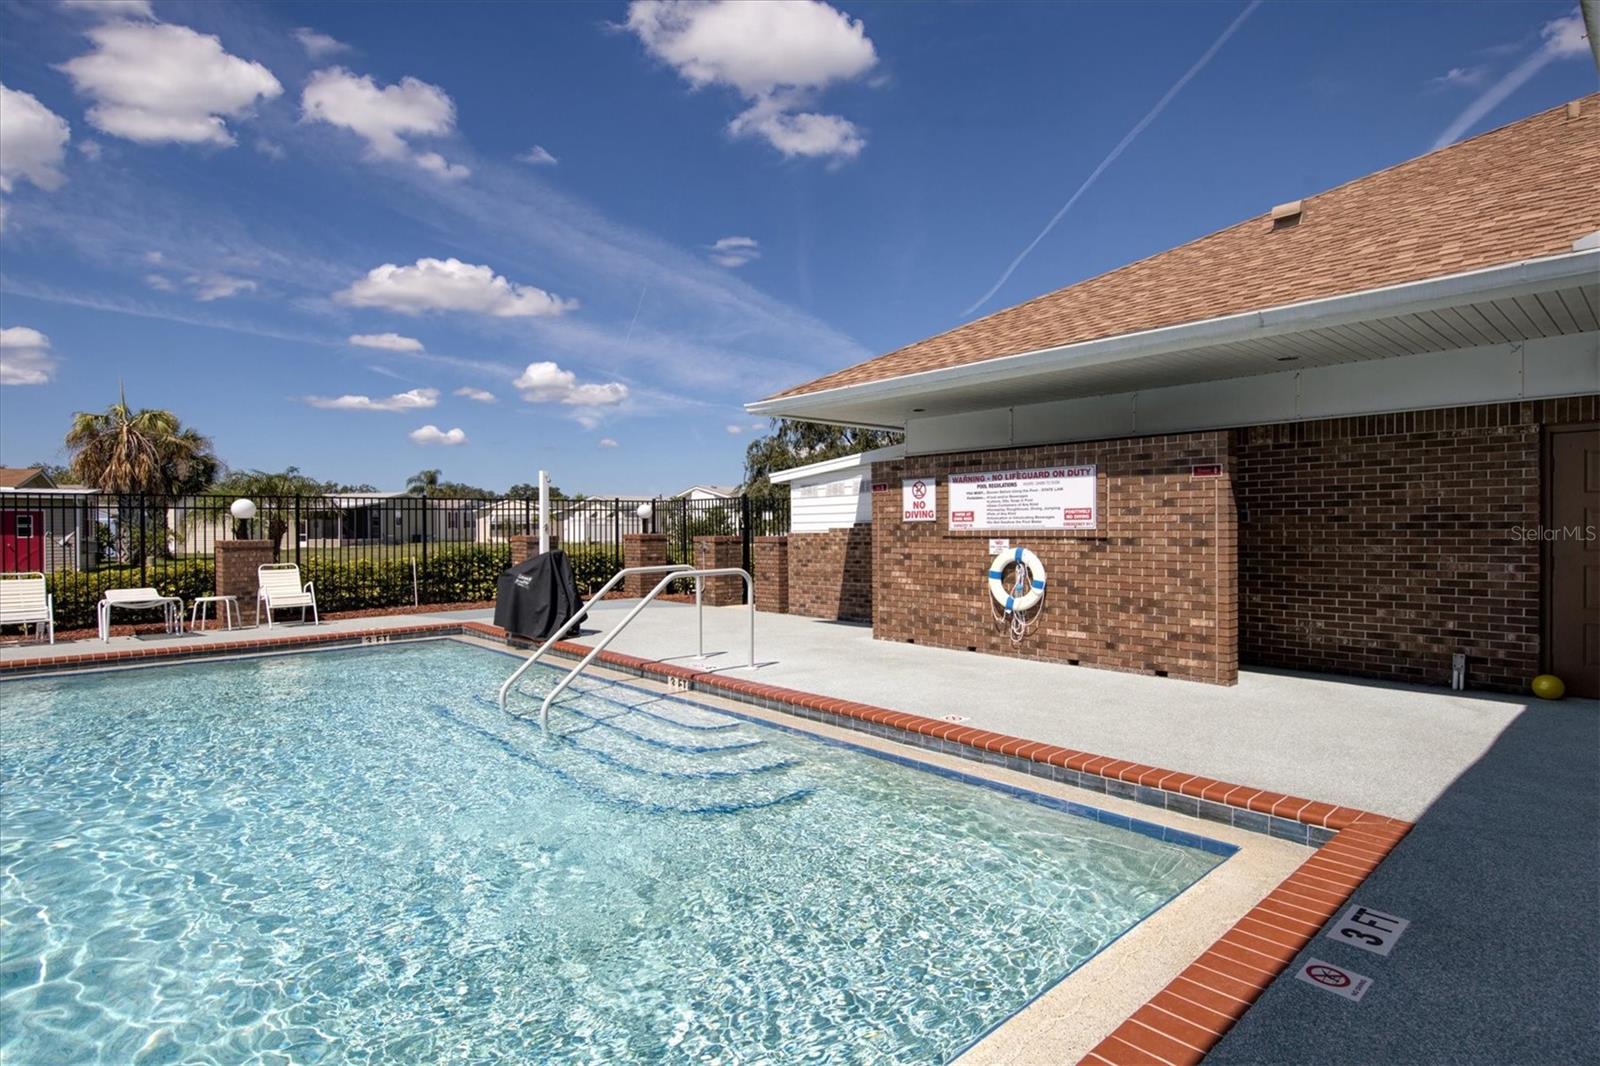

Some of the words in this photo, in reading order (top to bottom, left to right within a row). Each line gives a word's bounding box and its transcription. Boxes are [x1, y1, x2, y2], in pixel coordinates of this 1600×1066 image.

[952, 475, 985, 483] WARNING
[1005, 470, 1050, 481] LIFEGUARD
[1052, 470, 1065, 478] ON
[1067, 468, 1091, 477] DUTY
[913, 501, 926, 509] NO
[905, 511, 934, 519] DIVING
[376, 634, 388, 643] FT
[678, 679, 687, 689] FT
[1351, 908, 1399, 933] FT
[1341, 928, 1384, 946] 3
